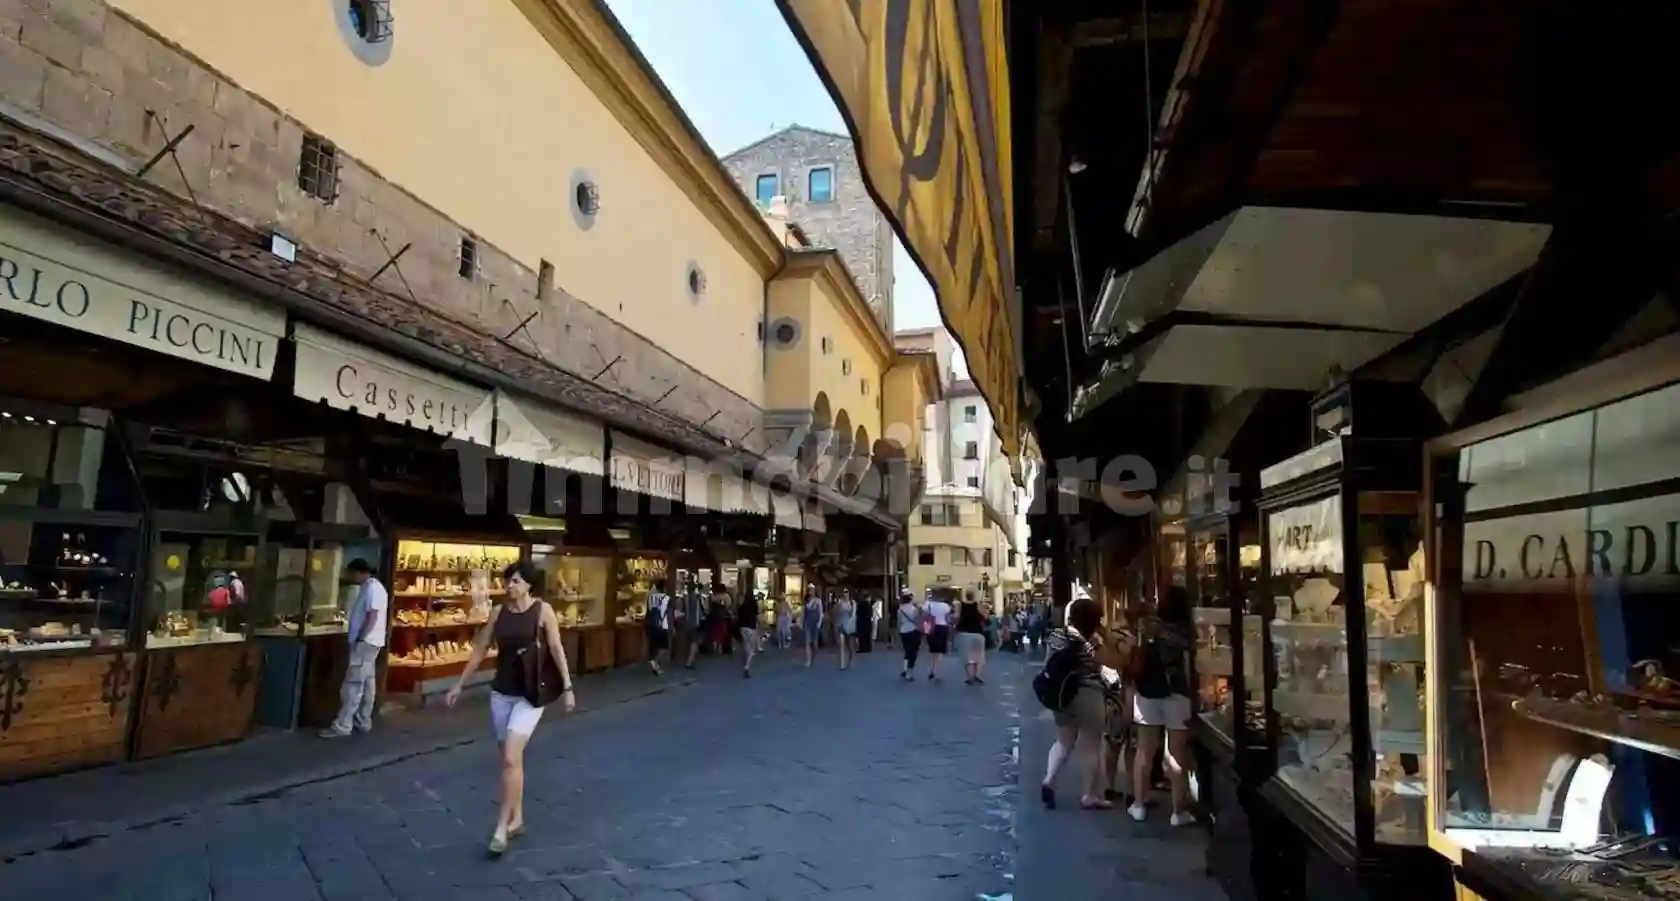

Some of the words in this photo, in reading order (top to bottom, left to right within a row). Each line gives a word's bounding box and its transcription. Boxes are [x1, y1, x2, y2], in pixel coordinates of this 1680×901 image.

[127, 299, 265, 369] PICCINI
[336, 364, 469, 431] Cassetti
[1475, 540, 1506, 579] D.
